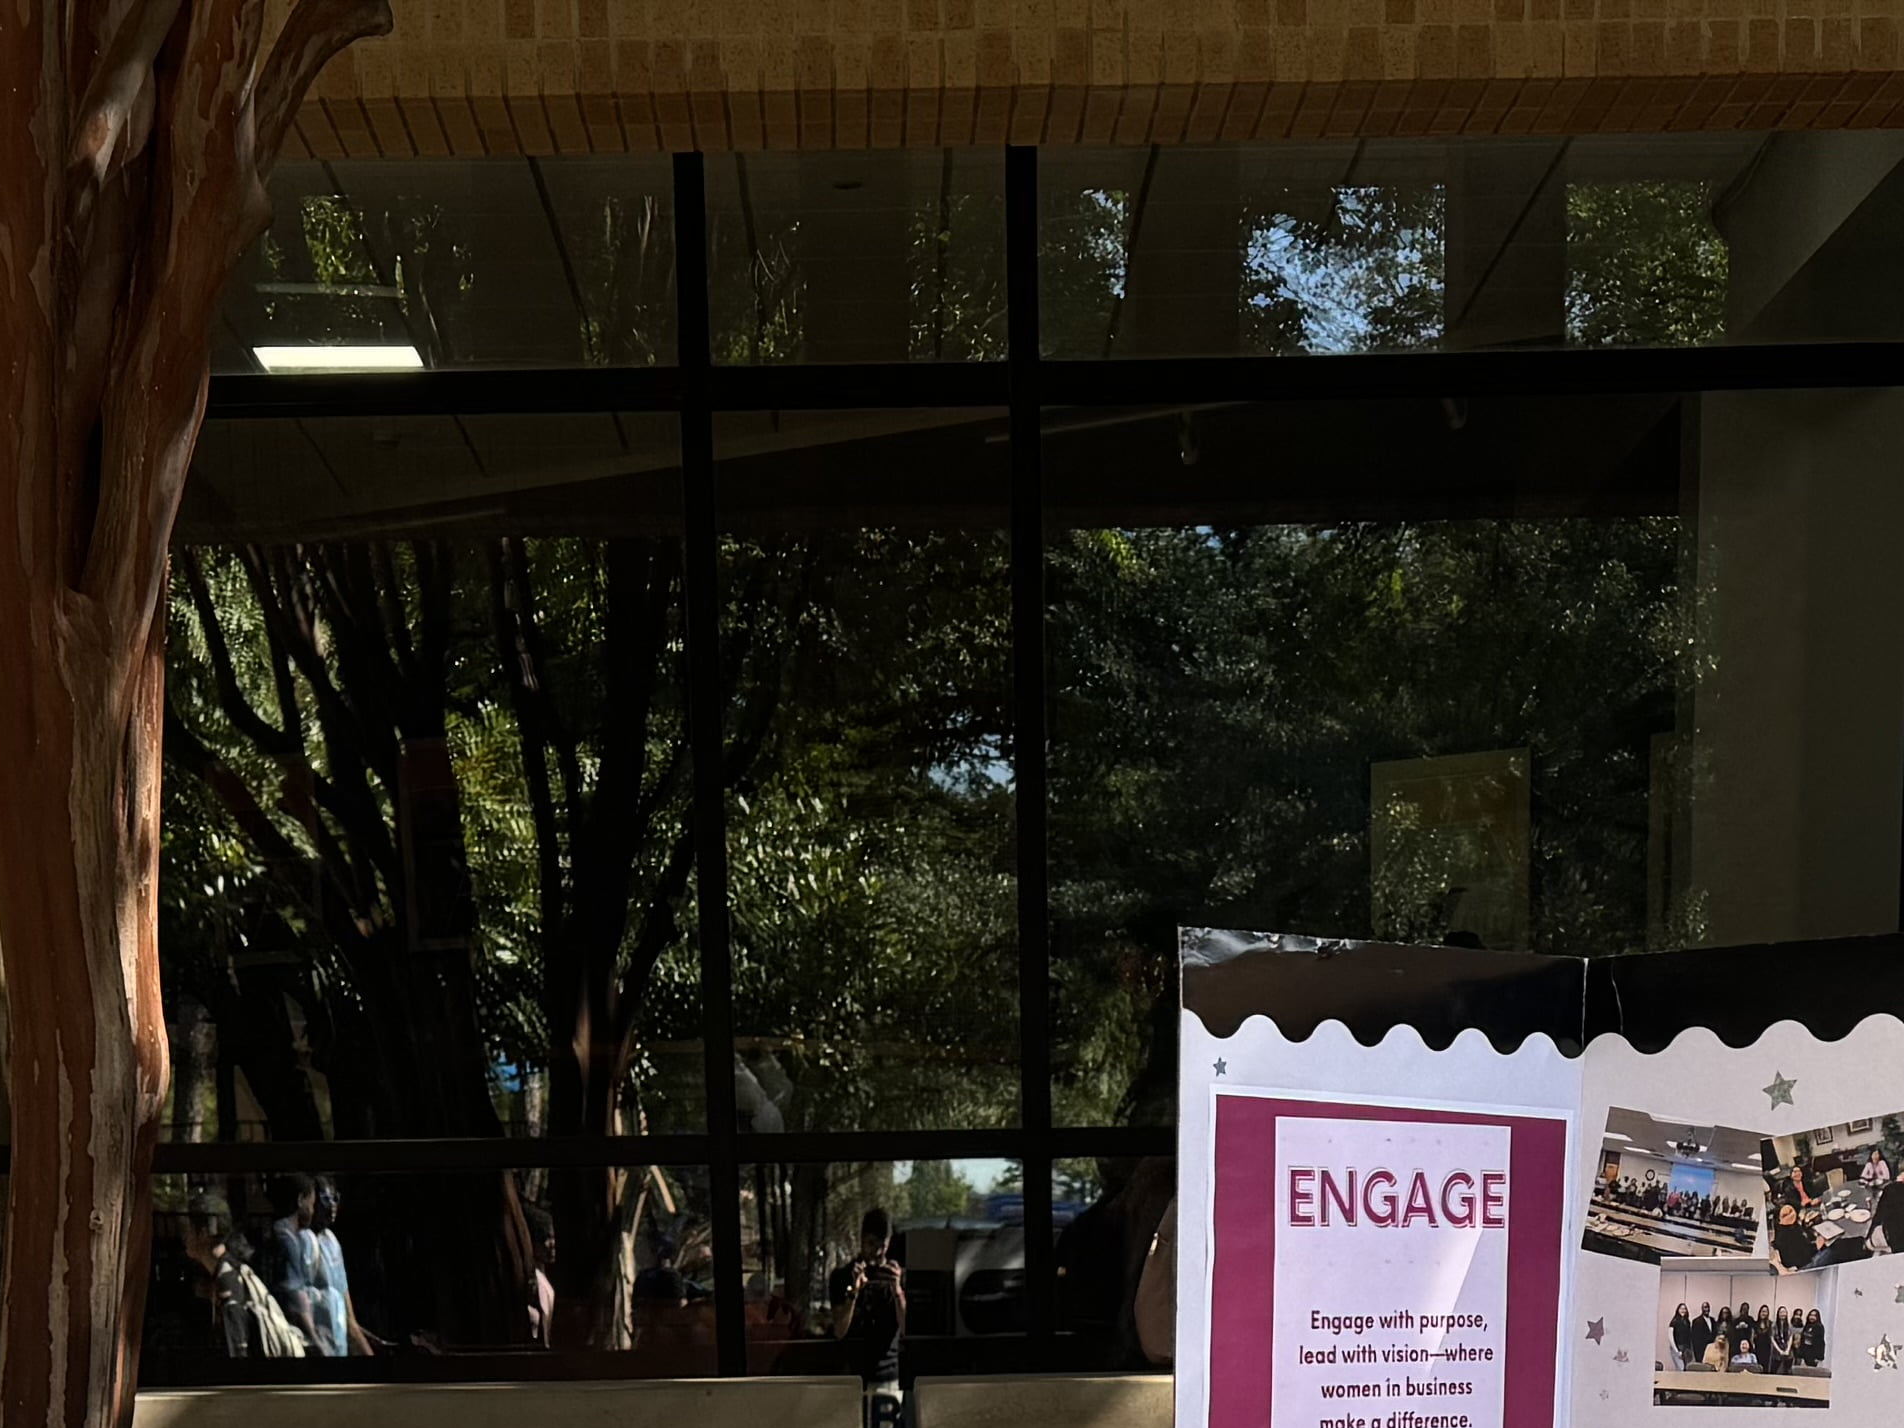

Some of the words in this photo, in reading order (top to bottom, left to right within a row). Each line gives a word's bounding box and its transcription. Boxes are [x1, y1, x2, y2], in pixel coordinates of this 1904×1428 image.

[1286, 1166, 1507, 1229] ENGAGE
[1310, 1310, 1374, 1333] Engage
[1379, 1310, 1415, 1330] with
[1419, 1310, 1488, 1335] purpose,
[1299, 1346, 1337, 1365] lead
[1341, 1345, 1377, 1365] with
[1321, 1380, 1381, 1398] women
[1385, 1378, 1401, 1397] in
[1406, 1376, 1472, 1396] business
